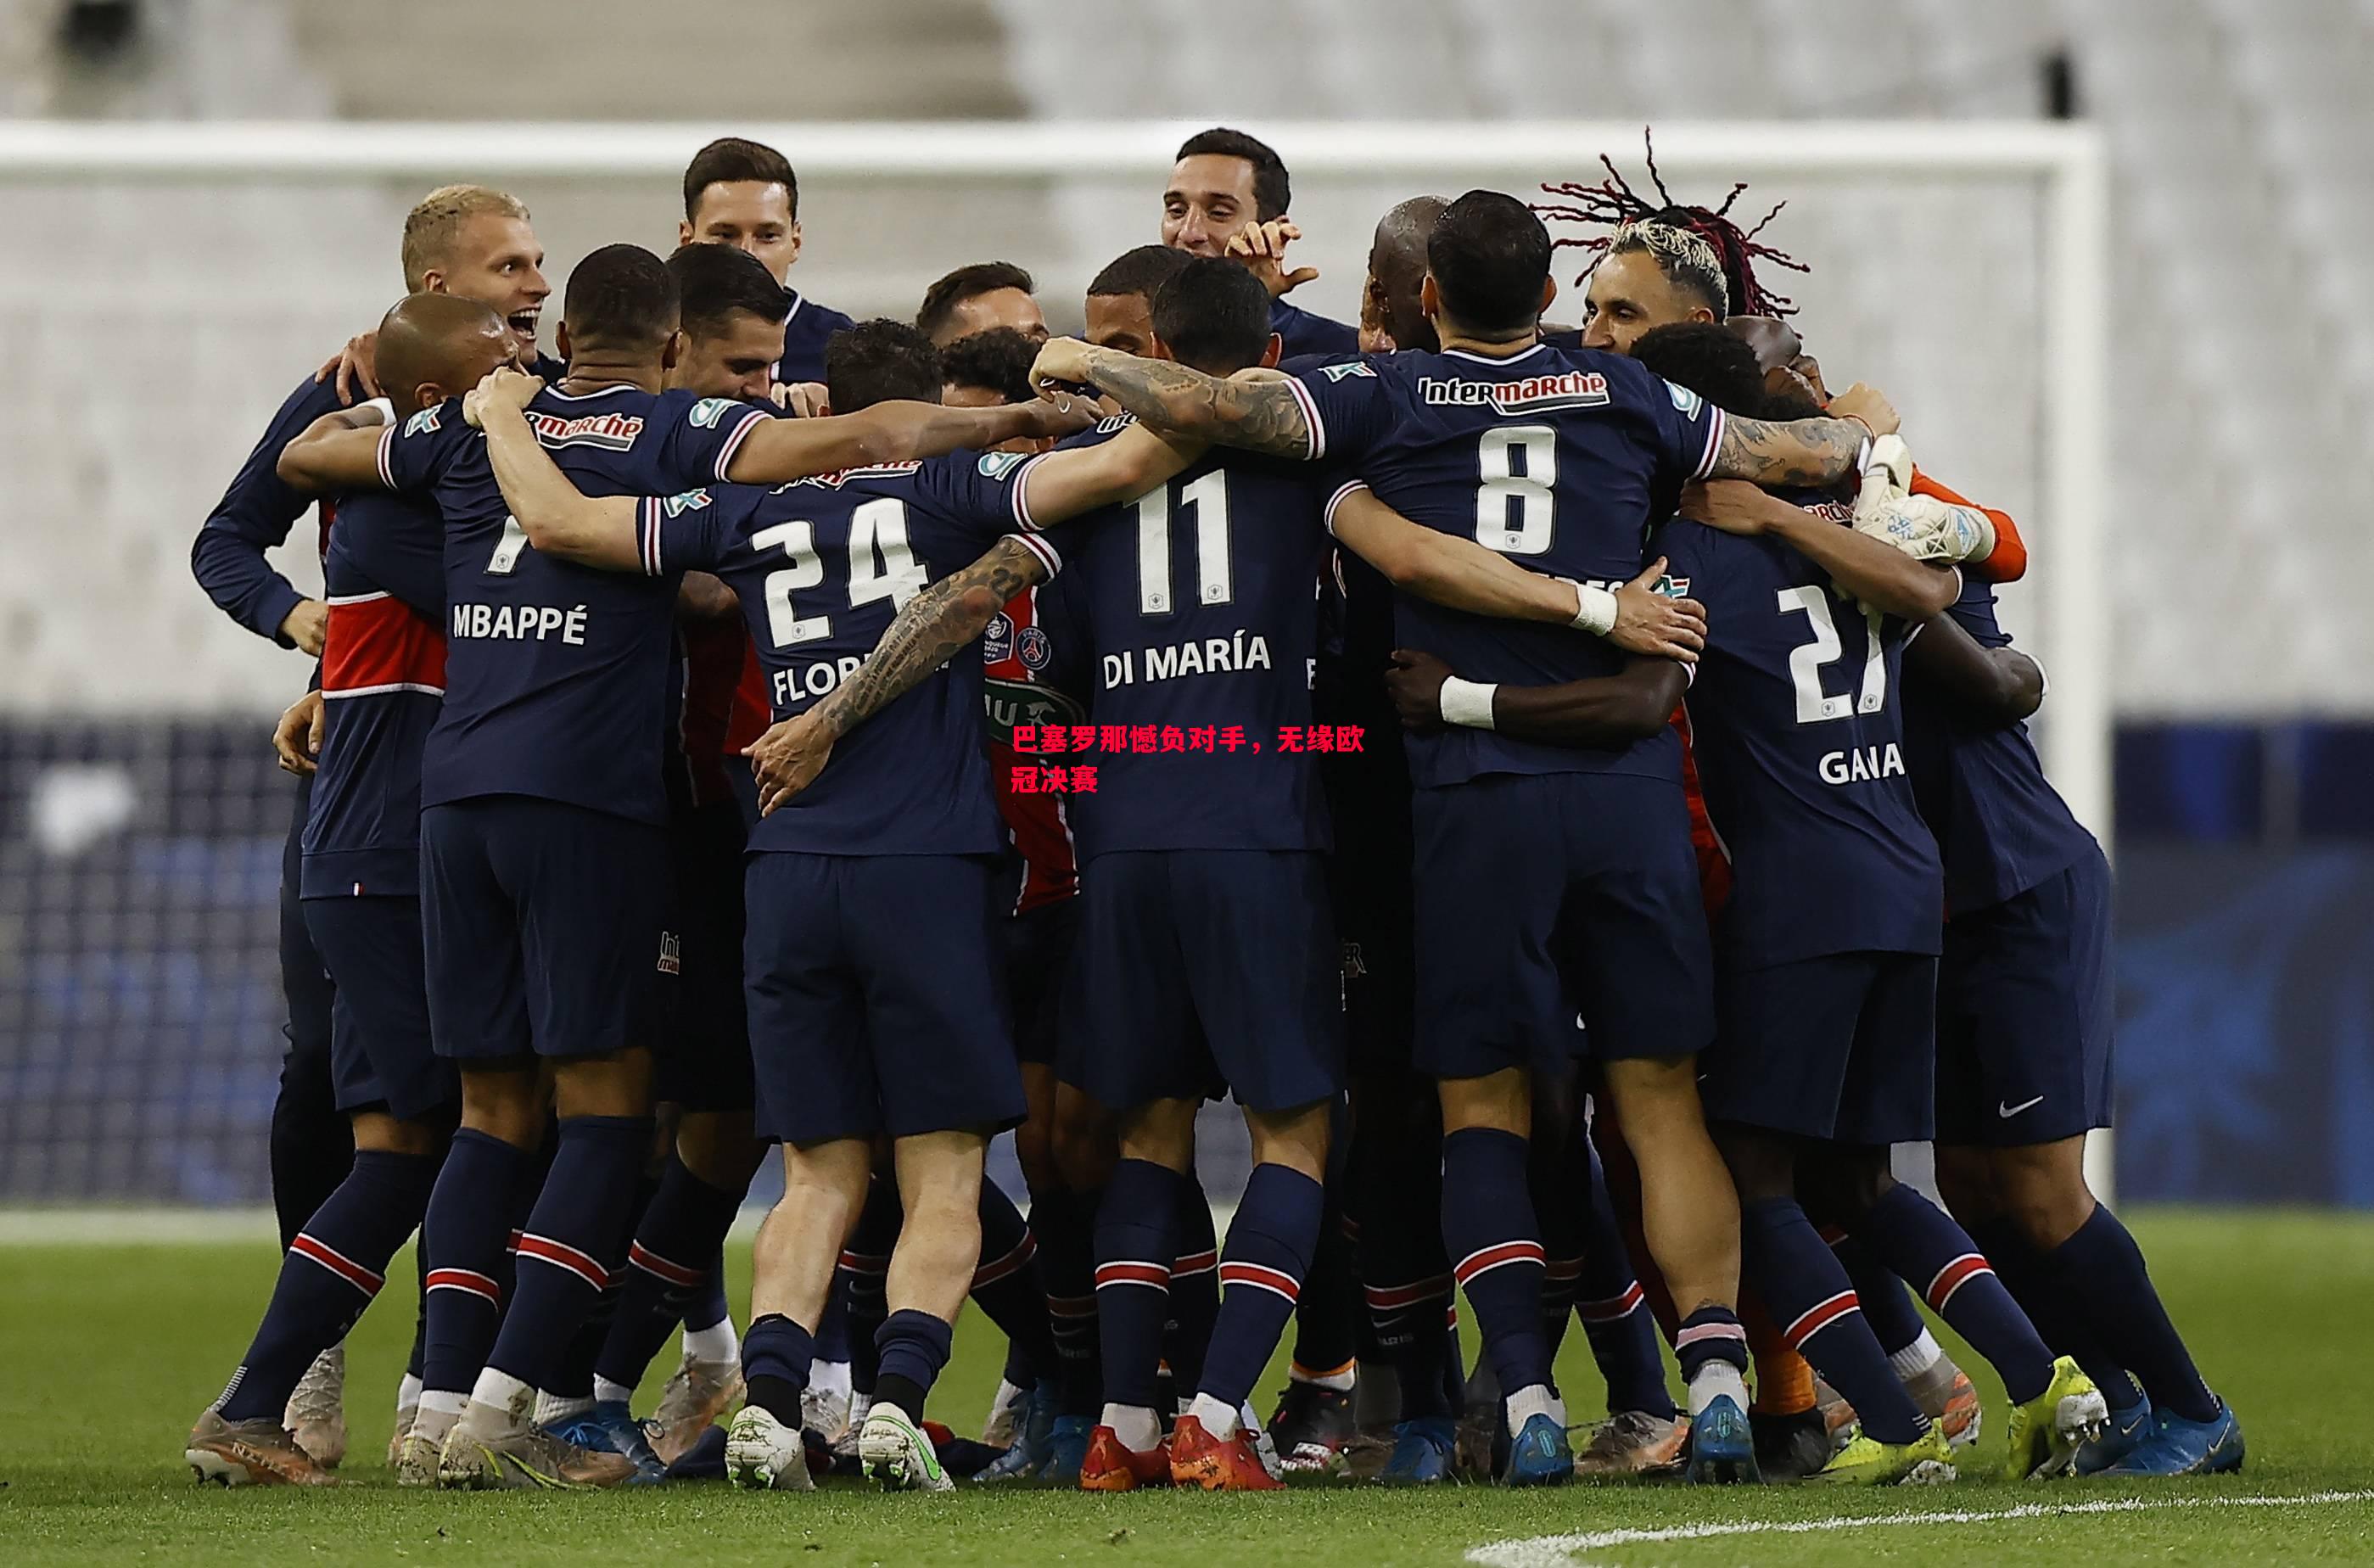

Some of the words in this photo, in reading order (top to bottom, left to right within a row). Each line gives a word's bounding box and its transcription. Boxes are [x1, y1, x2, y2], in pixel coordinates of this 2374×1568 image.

[1418, 372, 1607, 409] Intermarché
[526, 412, 644, 441] marché
[1475, 425, 1556, 555] 8
[1123, 468, 1230, 613] 11
[751, 497, 929, 647] 24
[453, 604, 588, 646] MBAPPÉ
[1104, 652, 1134, 689] DI
[1145, 630, 1271, 681] MARÍA
